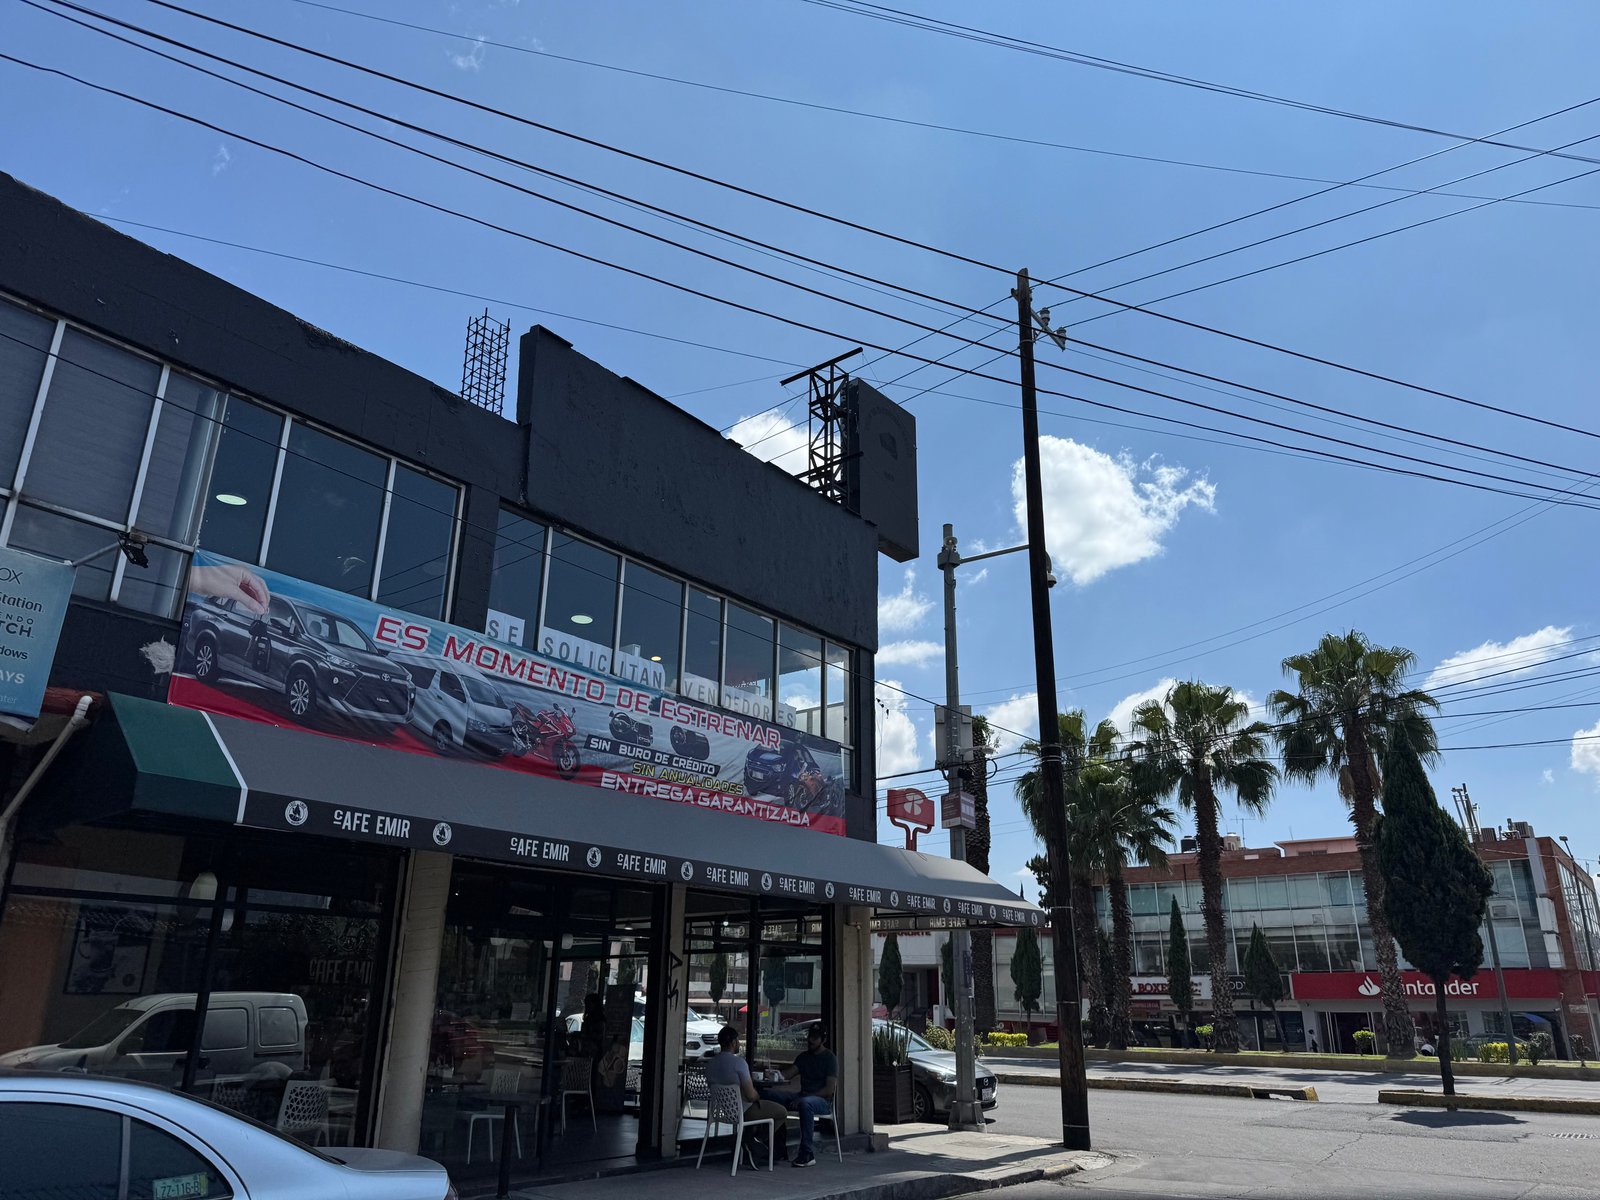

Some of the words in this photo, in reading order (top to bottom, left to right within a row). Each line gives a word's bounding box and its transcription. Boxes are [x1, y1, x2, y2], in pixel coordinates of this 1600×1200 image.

[375, 616, 429, 651] ES
[443, 635, 606, 701] MOMENTO
[616, 687, 650, 714] DE
[661, 700, 781, 749] ESTRENAR
[488, 620, 519, 645] SE
[543, 637, 662, 689] SOLICITAN
[683, 680, 794, 727] VENDEDORES
[589, 737, 611, 751] SIN
[618, 744, 652, 761] BURO
[654, 752, 670, 764] DE
[672, 755, 716, 774] CRÉDITO
[632, 762, 656, 778] SIN
[659, 770, 745, 795] ANUALIDADES
[601, 772, 695, 804] ENTREGA
[698, 792, 810, 827] GARANTIZADA
[333, 809, 371, 833] CAFE
[376, 815, 410, 838] EMIR
[510, 837, 539, 857] CAFE
[542, 842, 570, 862] EMIR
[617, 852, 641, 872] CAFE
[644, 857, 667, 875] EMIR
[706, 866, 727, 884] CAFE
[730, 870, 749, 886] EMIR
[779, 877, 796, 892] CAFE
[799, 880, 815, 895] EMIR
[867, 889, 881, 903] EMIR
[922, 896, 936, 910] EMIR
[1398, 979, 1479, 995] ntader
